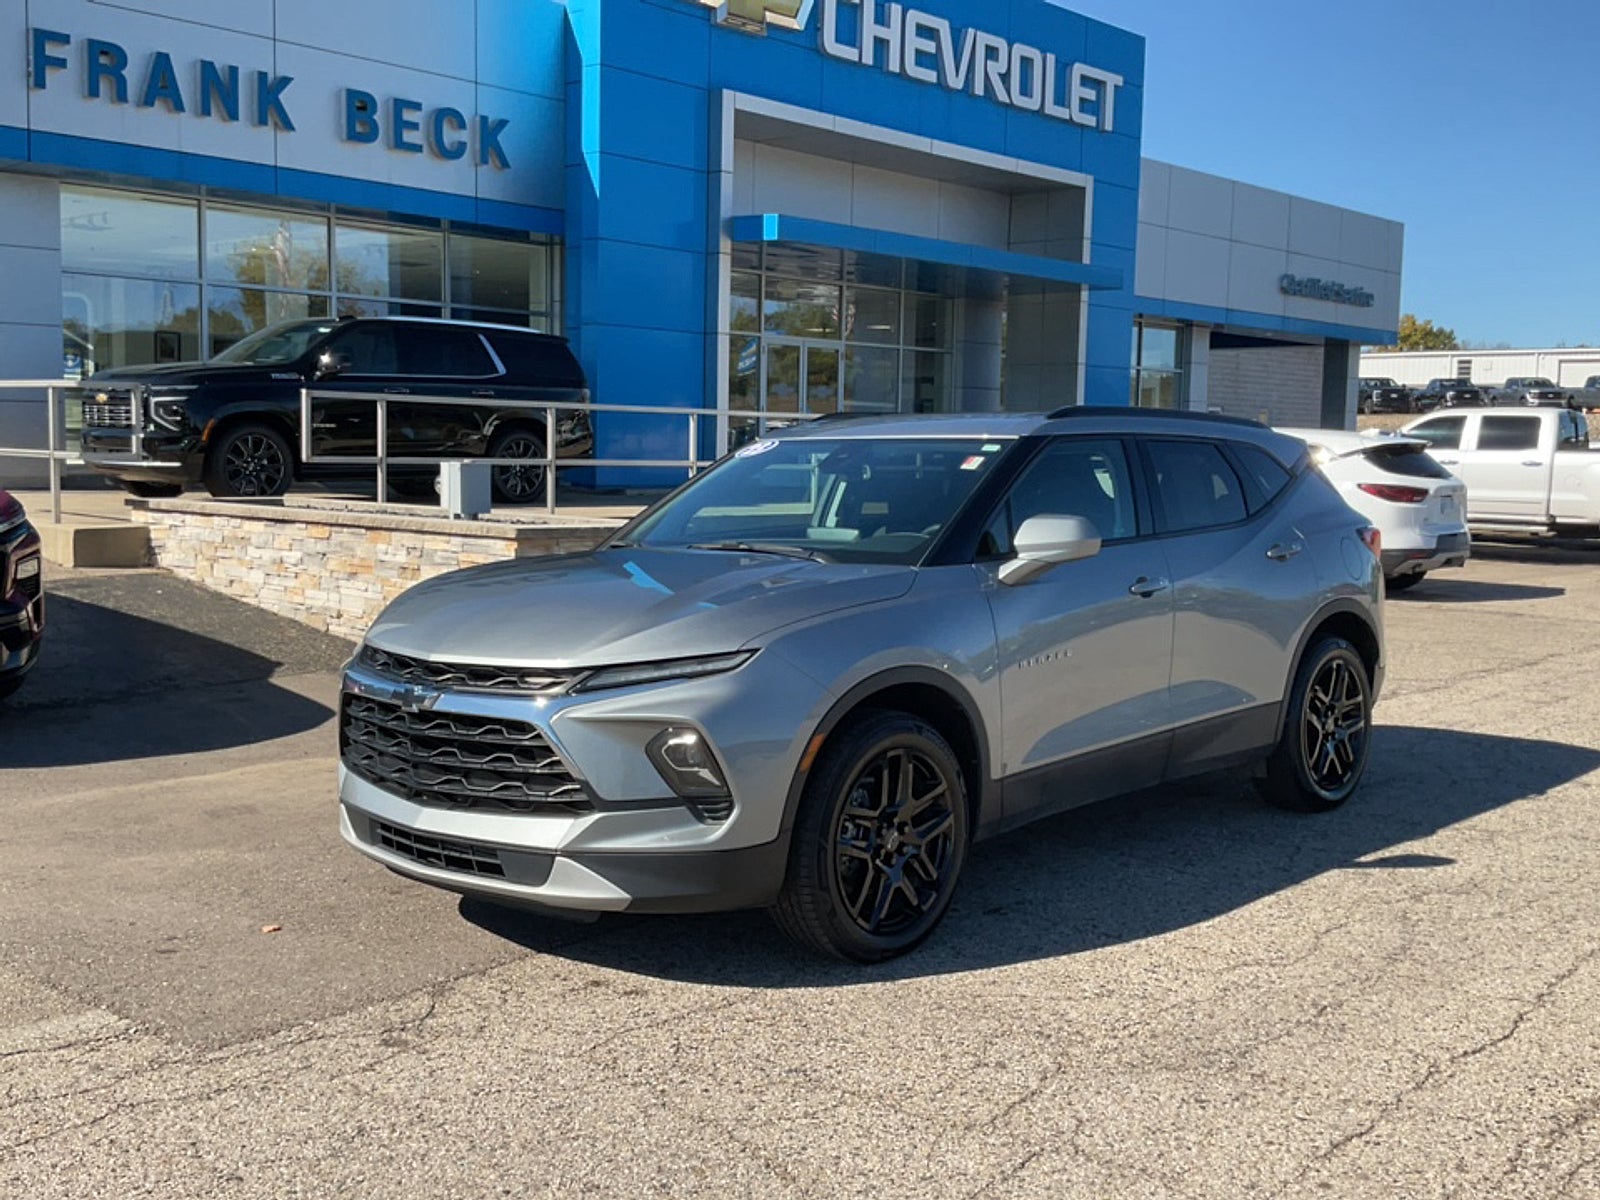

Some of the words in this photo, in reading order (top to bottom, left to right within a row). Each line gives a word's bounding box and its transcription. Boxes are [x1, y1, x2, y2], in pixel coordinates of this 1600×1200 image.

[30, 27, 296, 131] FRANK
[343, 88, 511, 169] BECK
[819, 0, 1124, 131] CHEVROLET
